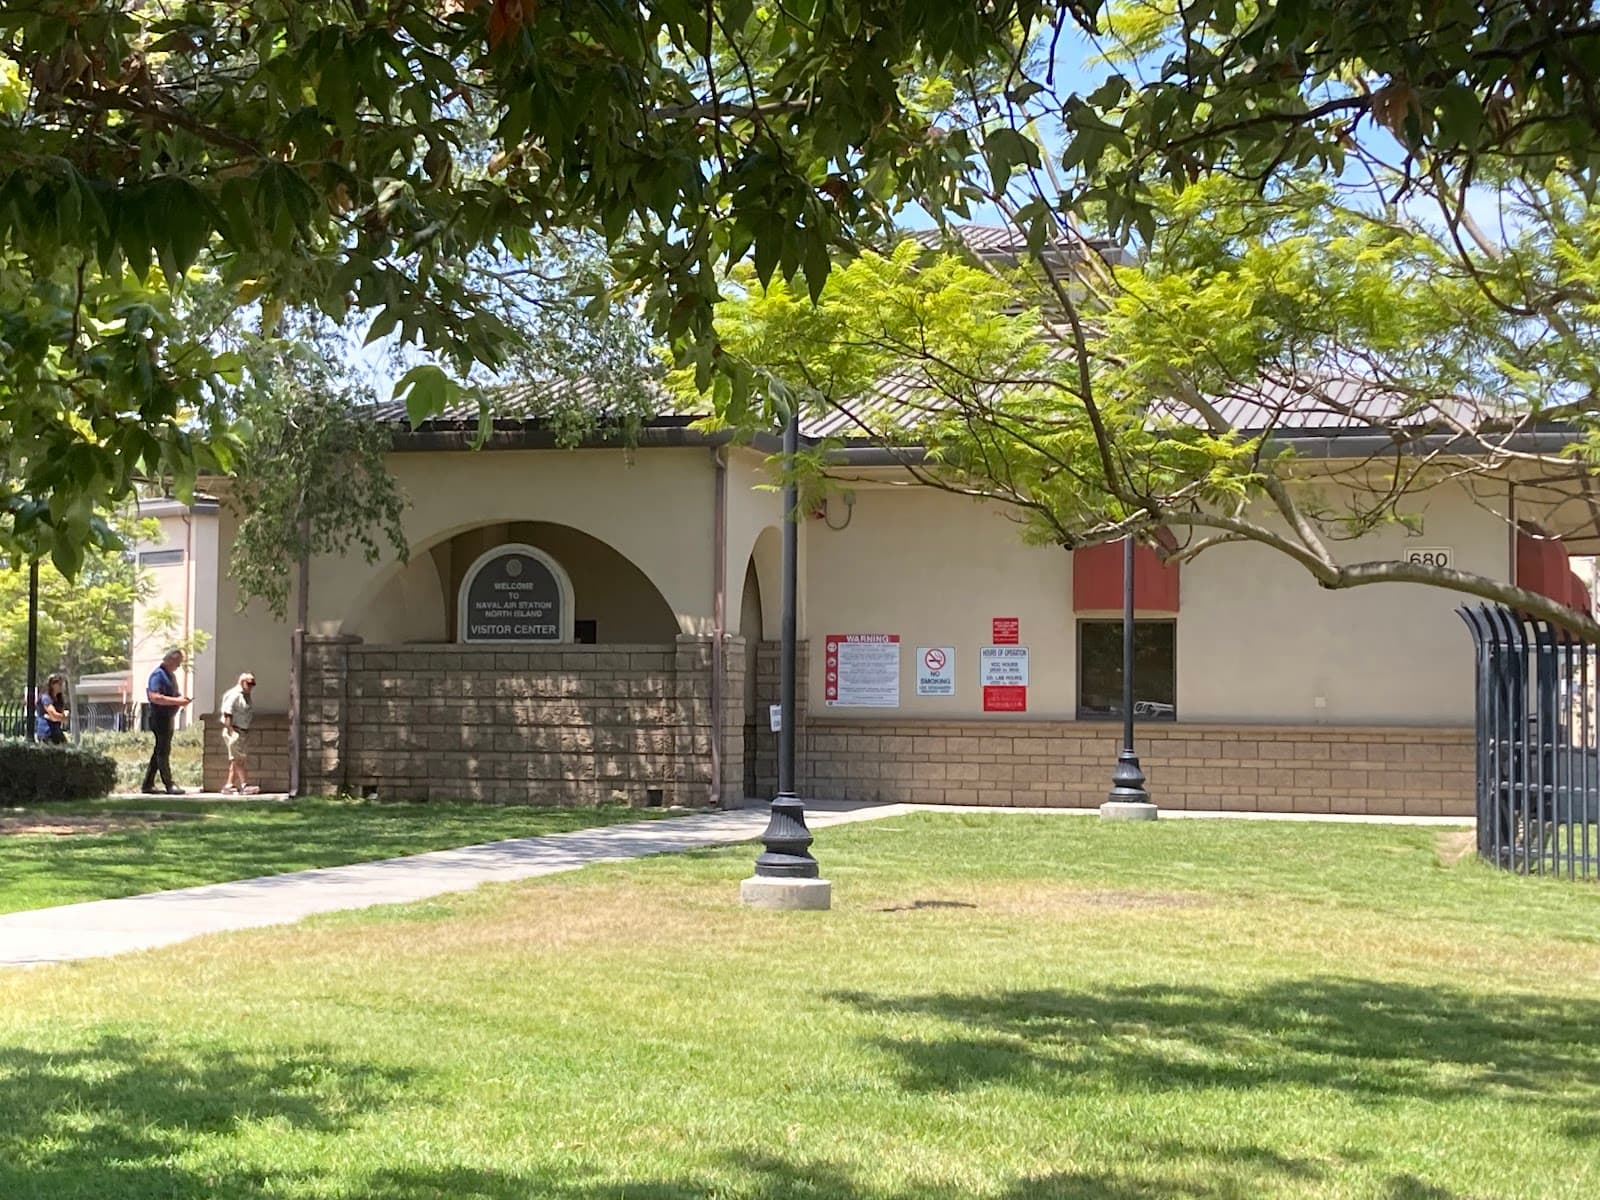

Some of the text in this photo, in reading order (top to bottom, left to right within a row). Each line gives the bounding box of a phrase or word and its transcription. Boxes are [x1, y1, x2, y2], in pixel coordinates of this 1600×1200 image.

[1410, 553, 1447, 568] 680
[509, 592, 519, 600] TO
[471, 625, 556, 634] VISITOR CENTER
[846, 635, 889, 643] WARNING
